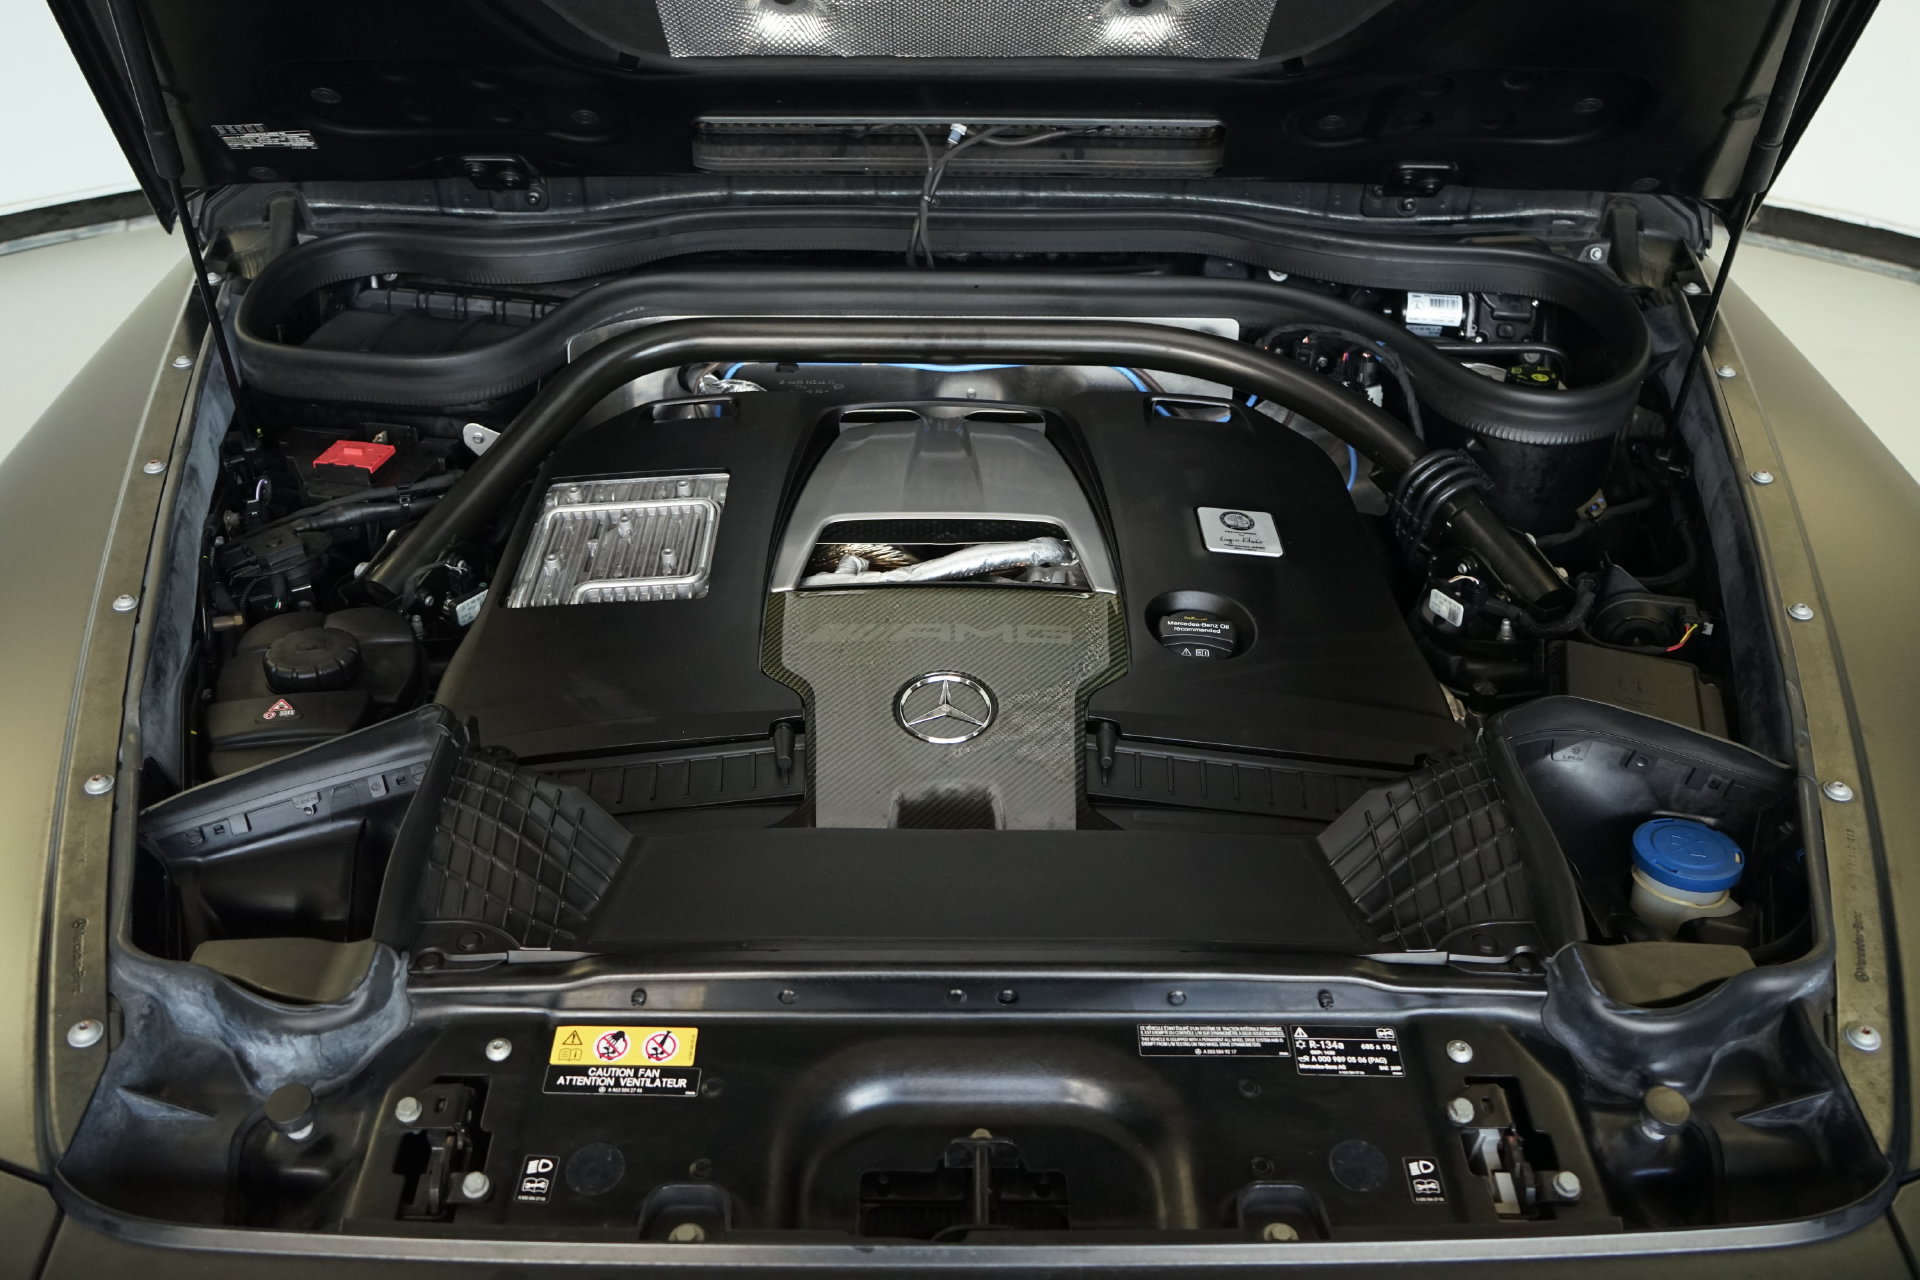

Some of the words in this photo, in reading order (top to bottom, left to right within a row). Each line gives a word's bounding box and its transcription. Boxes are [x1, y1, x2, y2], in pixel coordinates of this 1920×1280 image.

[1168, 620, 1218, 628] Mercedes-Benz
[1309, 1040, 1345, 1050] R-134a
[588, 1068, 634, 1076] CAUTION
[638, 1069, 660, 1077] FAN
[556, 1076, 615, 1086] ATTENTION
[620, 1077, 687, 1088] VENTILATEUR
